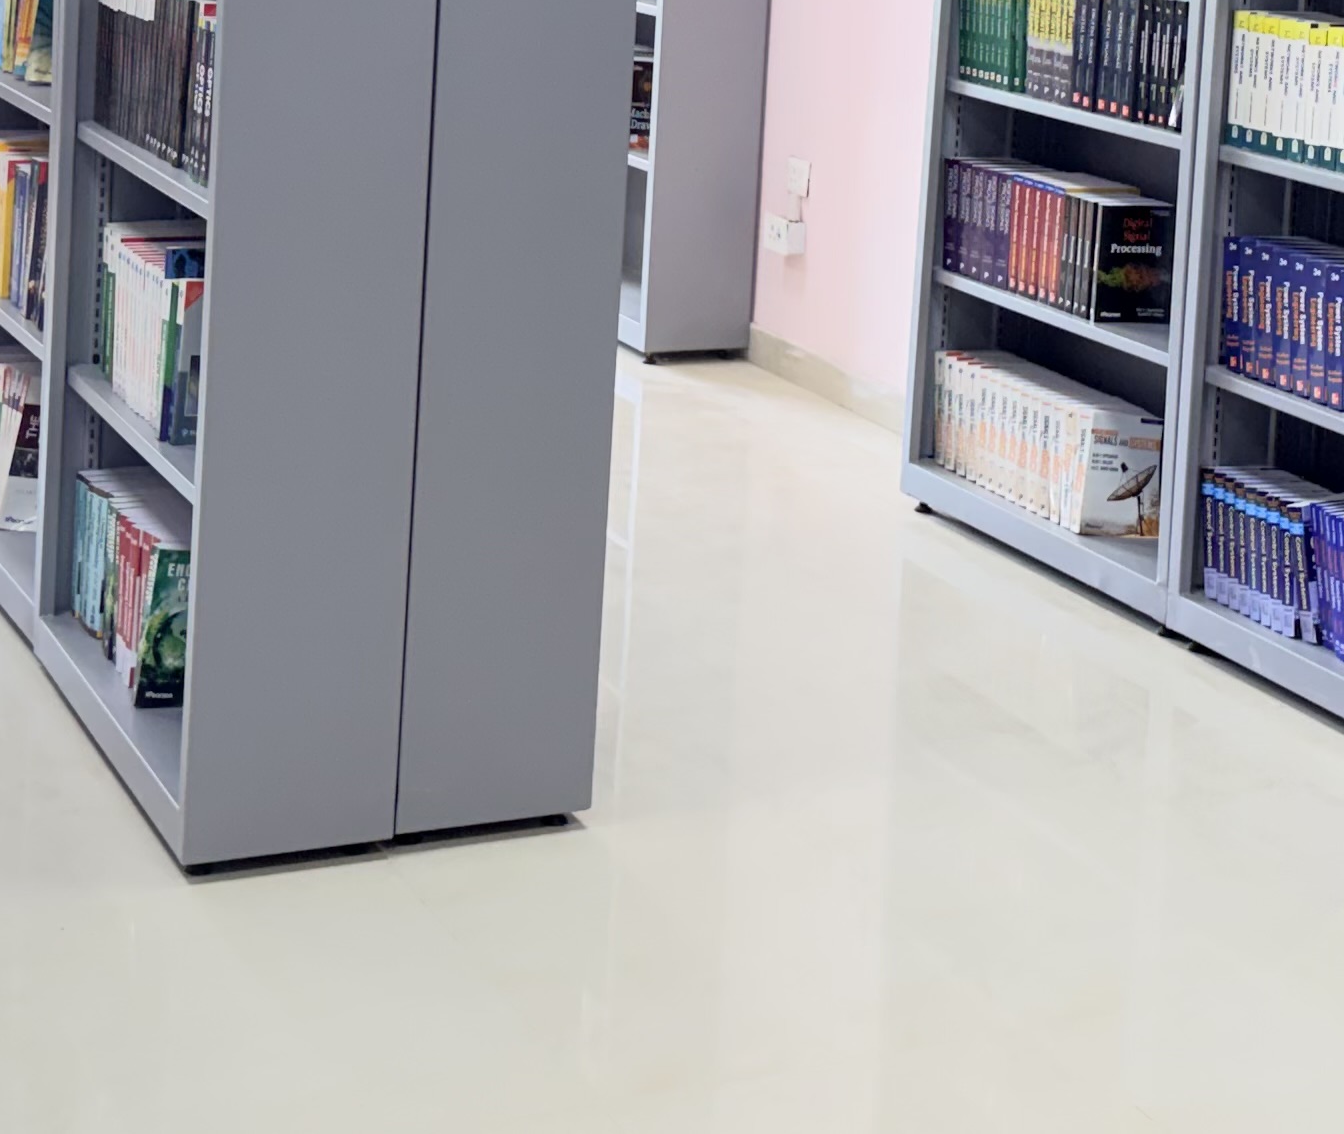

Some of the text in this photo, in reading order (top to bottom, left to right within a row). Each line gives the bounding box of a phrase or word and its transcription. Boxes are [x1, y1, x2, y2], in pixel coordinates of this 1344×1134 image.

[197, 64, 205, 114] OPTICS
[204, 67, 213, 117] OPTICS
[1110, 243, 1163, 257] Processing
[1295, 536, 1307, 610] Control Systems
